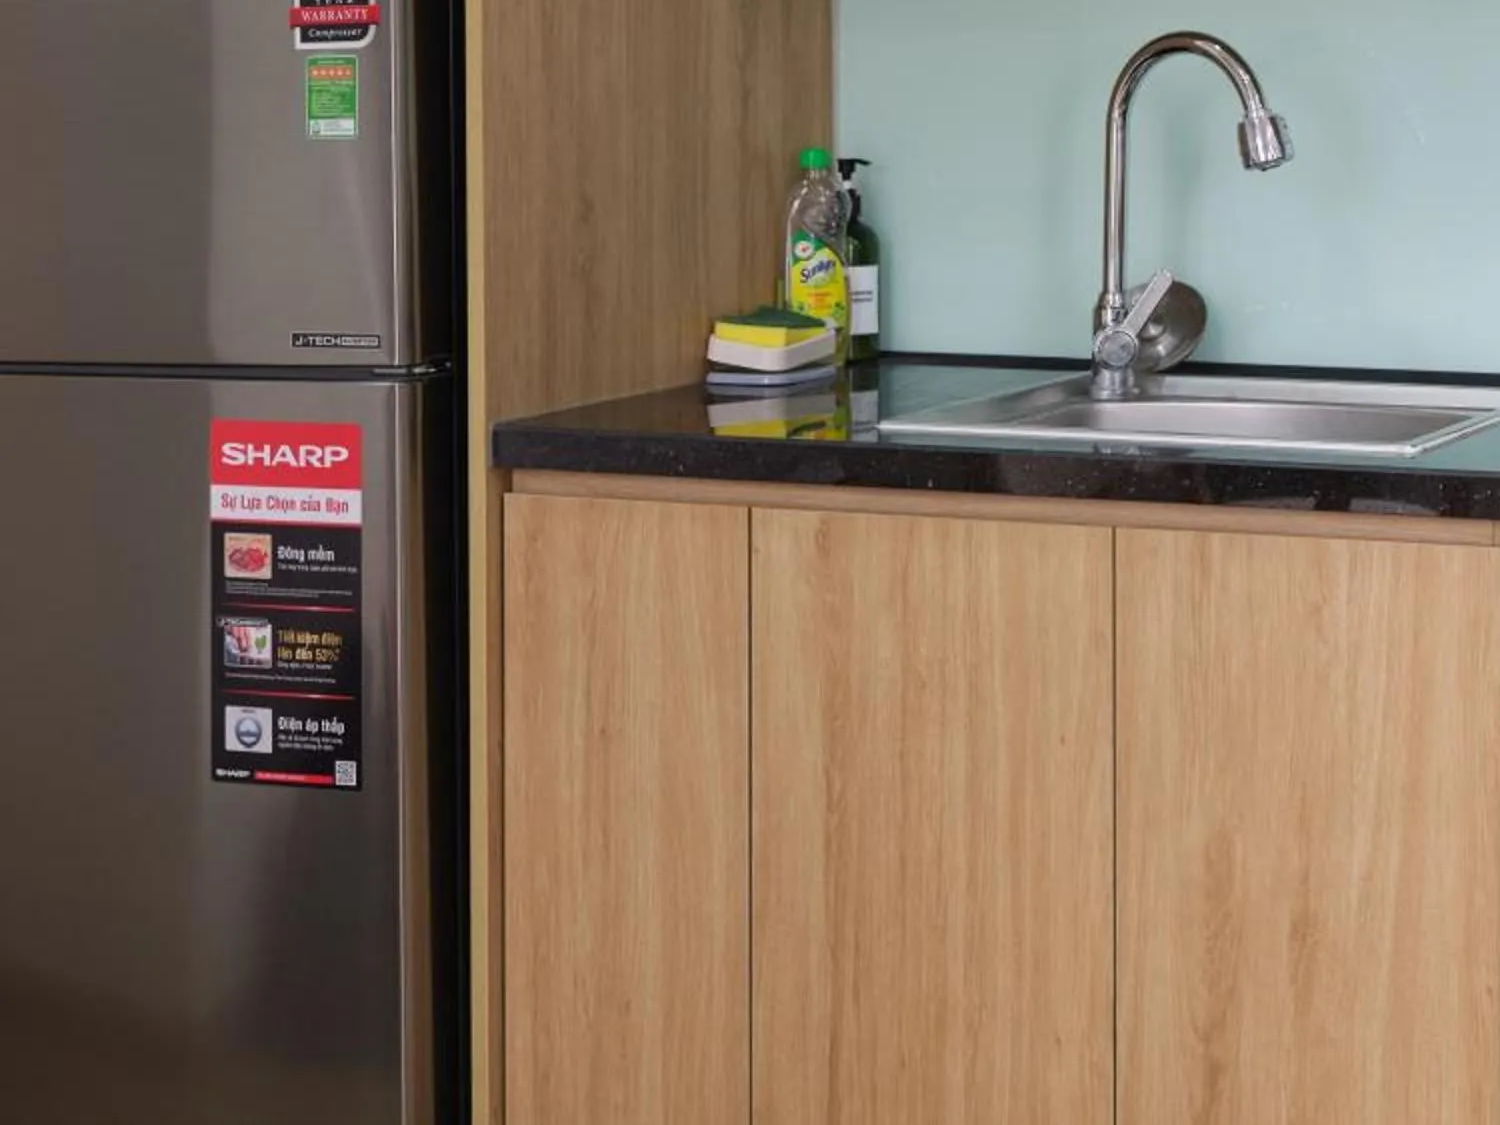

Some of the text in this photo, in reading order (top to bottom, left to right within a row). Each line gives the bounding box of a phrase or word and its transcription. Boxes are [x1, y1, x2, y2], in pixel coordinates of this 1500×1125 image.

[301, 8, 369, 22] WARRANTY
[220, 441, 350, 468] SHARP
[221, 492, 349, 514] Sự Lựa Chọn của Bạn
